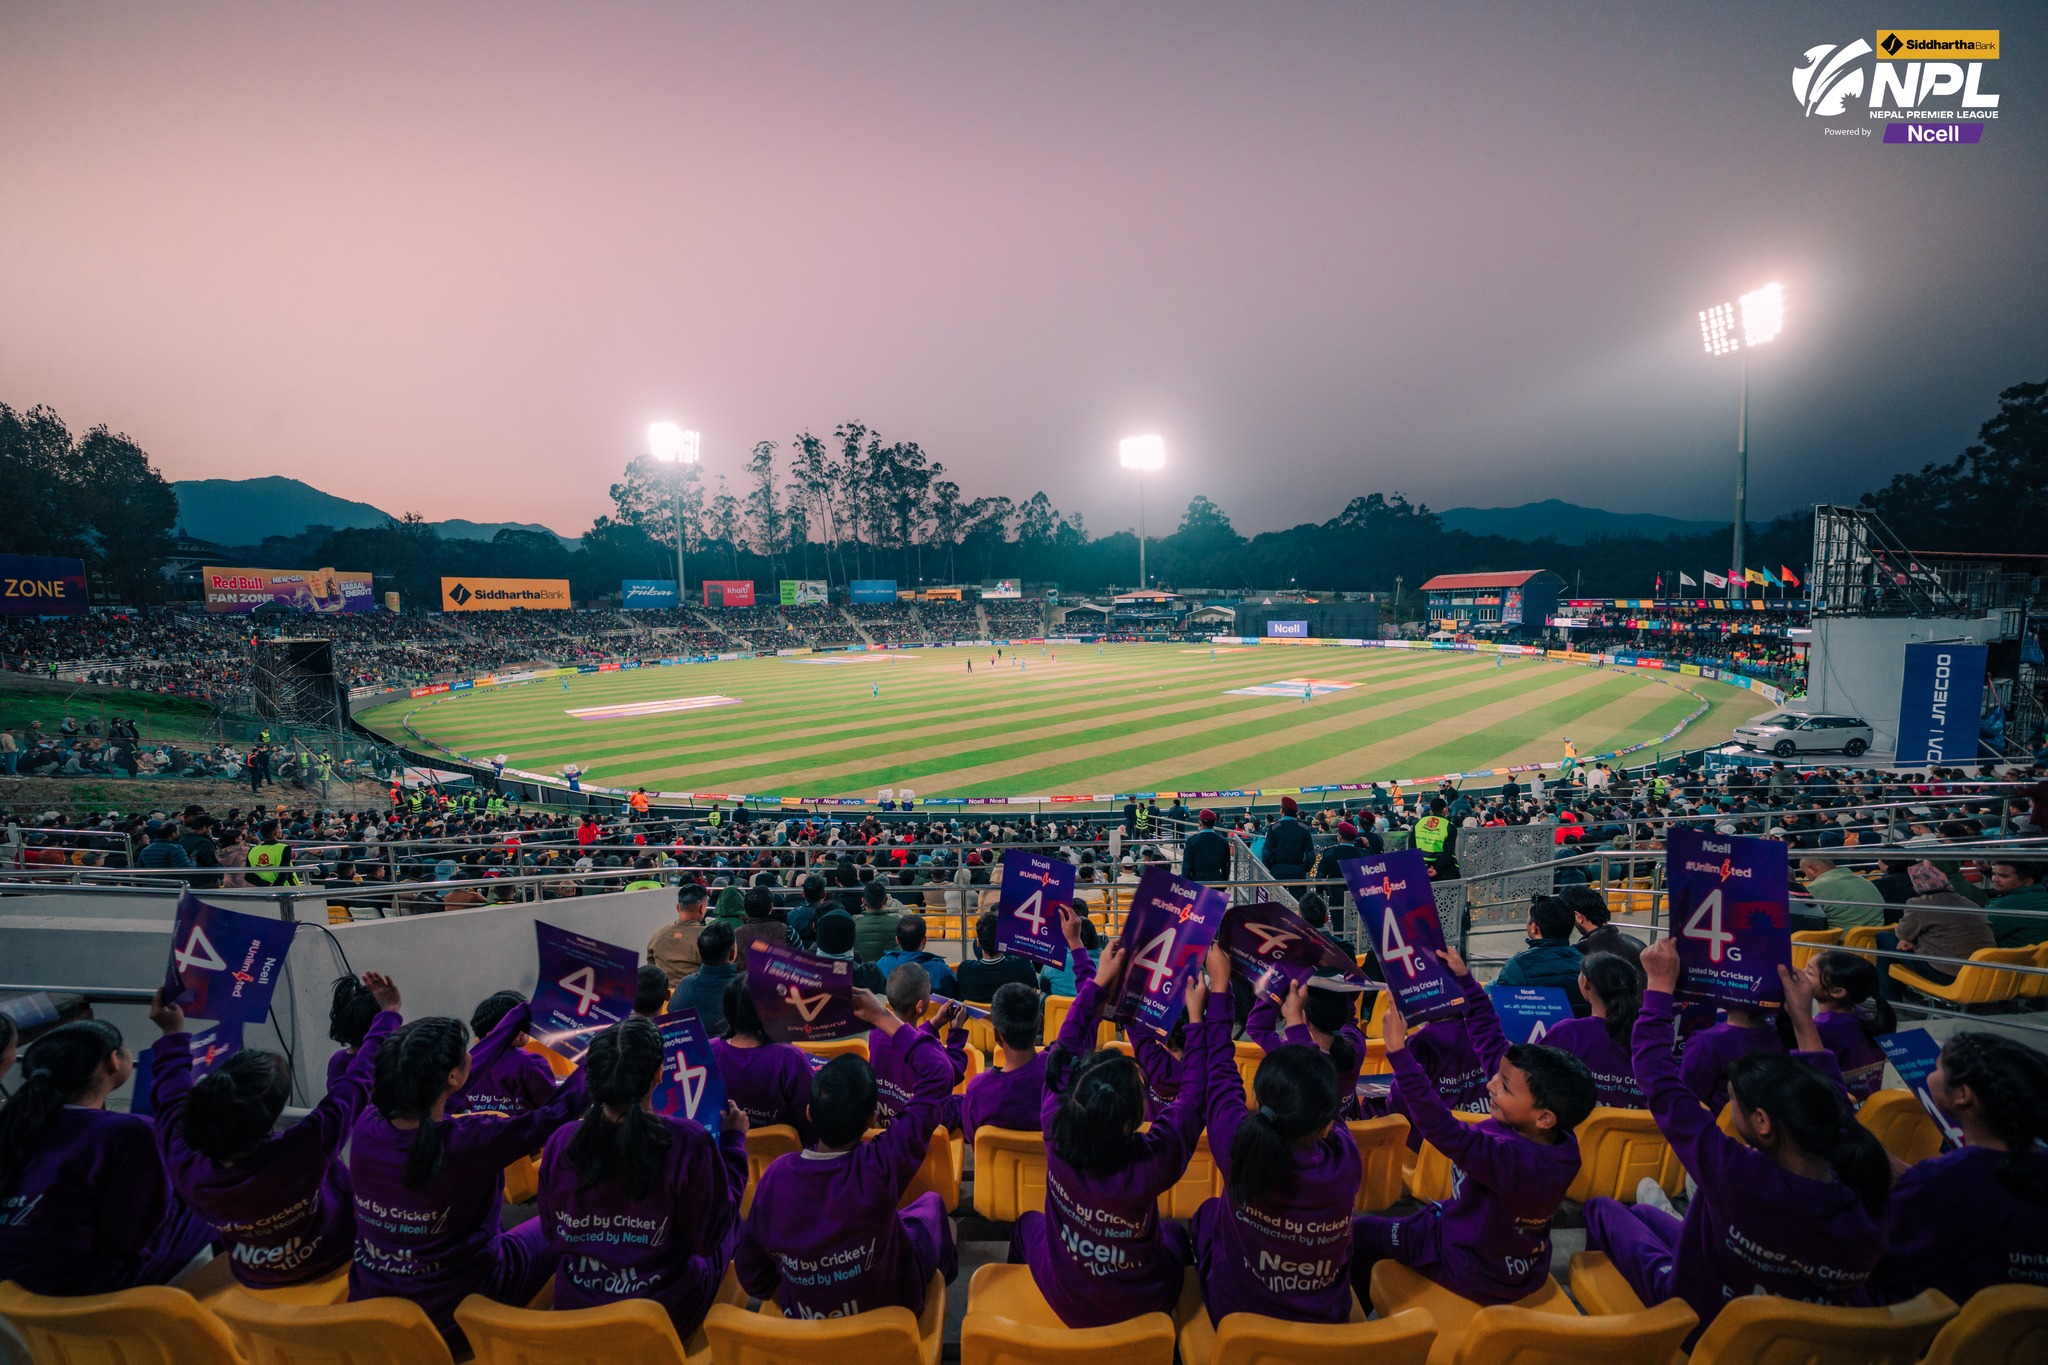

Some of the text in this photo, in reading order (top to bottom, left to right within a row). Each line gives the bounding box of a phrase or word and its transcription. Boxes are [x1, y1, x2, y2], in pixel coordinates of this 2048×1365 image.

[4, 578, 66, 598] ZONE
[212, 575, 265, 590] Red Bull
[208, 594, 275, 603] FAN ZONE
[1274, 623, 1300, 633] Ncell
[1931, 653, 1951, 726] JAECOO
[1702, 840, 1731, 854] Ncell
[1031, 859, 1051, 870] Ncell
[1360, 862, 1387, 876] Ncell
[1169, 882, 1198, 901] Ncell
[1014, 933, 1052, 949] United by Cricket
[257, 957, 277, 985] Ncell
[1688, 966, 1754, 983] United by Cricket
[558, 966, 601, 1017] 4
[1413, 984, 1420, 995] by
[1419, 980, 1440, 991] Cricket
[1716, 977, 1727, 987] by
[1728, 980, 1749, 990] Ncell
[1143, 996, 1151, 1006] by
[1427, 988, 1440, 997] Ncell
[673, 1051, 707, 1120] 4
[884, 1079, 894, 1090] by
[1611, 1075, 1623, 1083] by
[480, 1094, 492, 1103] by
[743, 1107, 771, 1117] Cricket
[256, 1199, 310, 1227] Cricket
[372, 1201, 439, 1222] by Cricket
[556, 1210, 656, 1230] United by Cricket
[1076, 1203, 1093, 1221] by
[1242, 1202, 1349, 1234] United by Cricket
[384, 1221, 428, 1235] by Ncell
[1104, 1228, 1132, 1239] Ncell
[1235, 1210, 1296, 1242] Connected
[1299, 1235, 1314, 1246] by
[1390, 1222, 1400, 1246] Ncell
[606, 1231, 620, 1245] by
[622, 1231, 648, 1244] Ncell
[1061, 1223, 1126, 1265] Ncell
[232, 1236, 301, 1265] Ncell
[800, 1245, 866, 1272] by Cricket
[1259, 1250, 1332, 1277] Ncell
[817, 1264, 862, 1286] by Ncell
